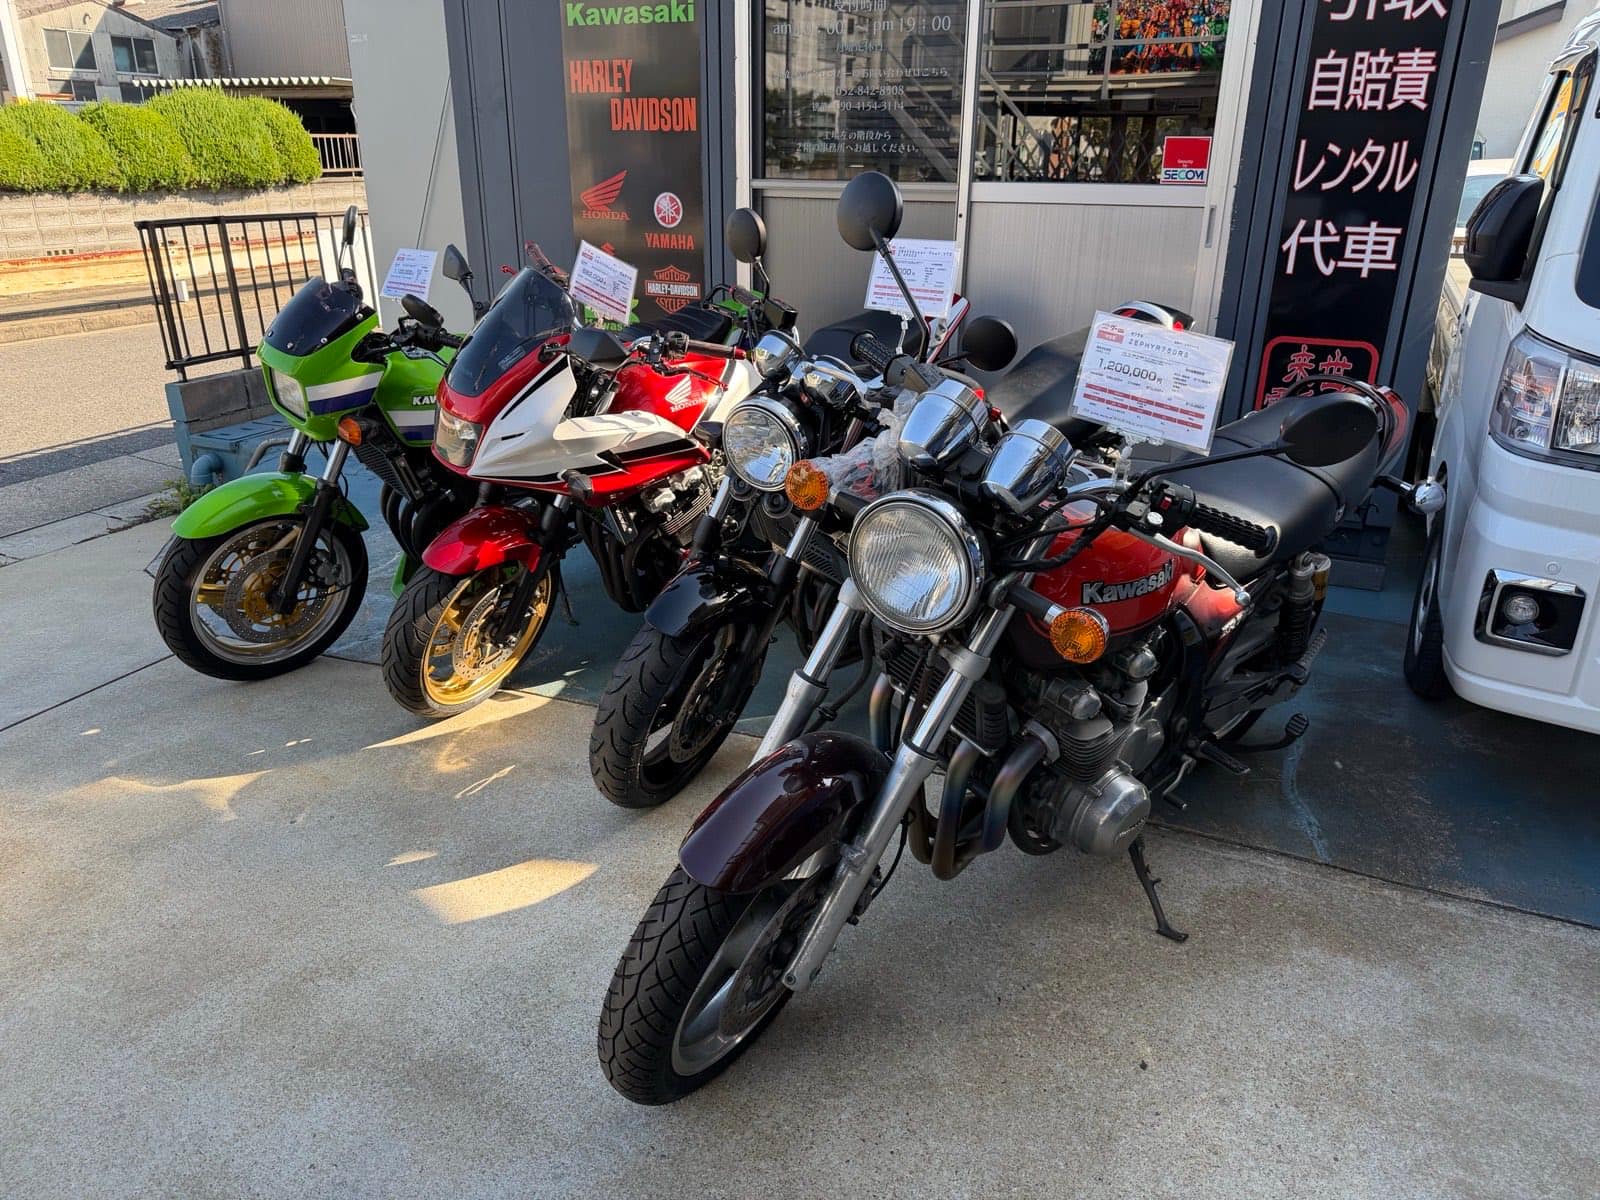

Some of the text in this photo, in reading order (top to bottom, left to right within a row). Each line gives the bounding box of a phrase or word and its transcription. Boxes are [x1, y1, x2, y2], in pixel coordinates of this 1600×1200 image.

[566, 0, 695, 27] Kawasaki
[569, 59, 633, 94] HARLEY
[1308, 47, 1437, 111] 自賠責
[610, 97, 697, 132] DAVIDSON
[1164, 169, 1204, 180] SECOM
[1292, 138, 1419, 193] レンタル
[581, 210, 630, 221] HONDA
[645, 233, 694, 250] YAMAHA
[1281, 218, 1402, 279] 代車
[1081, 557, 1175, 605] Kawasaki
